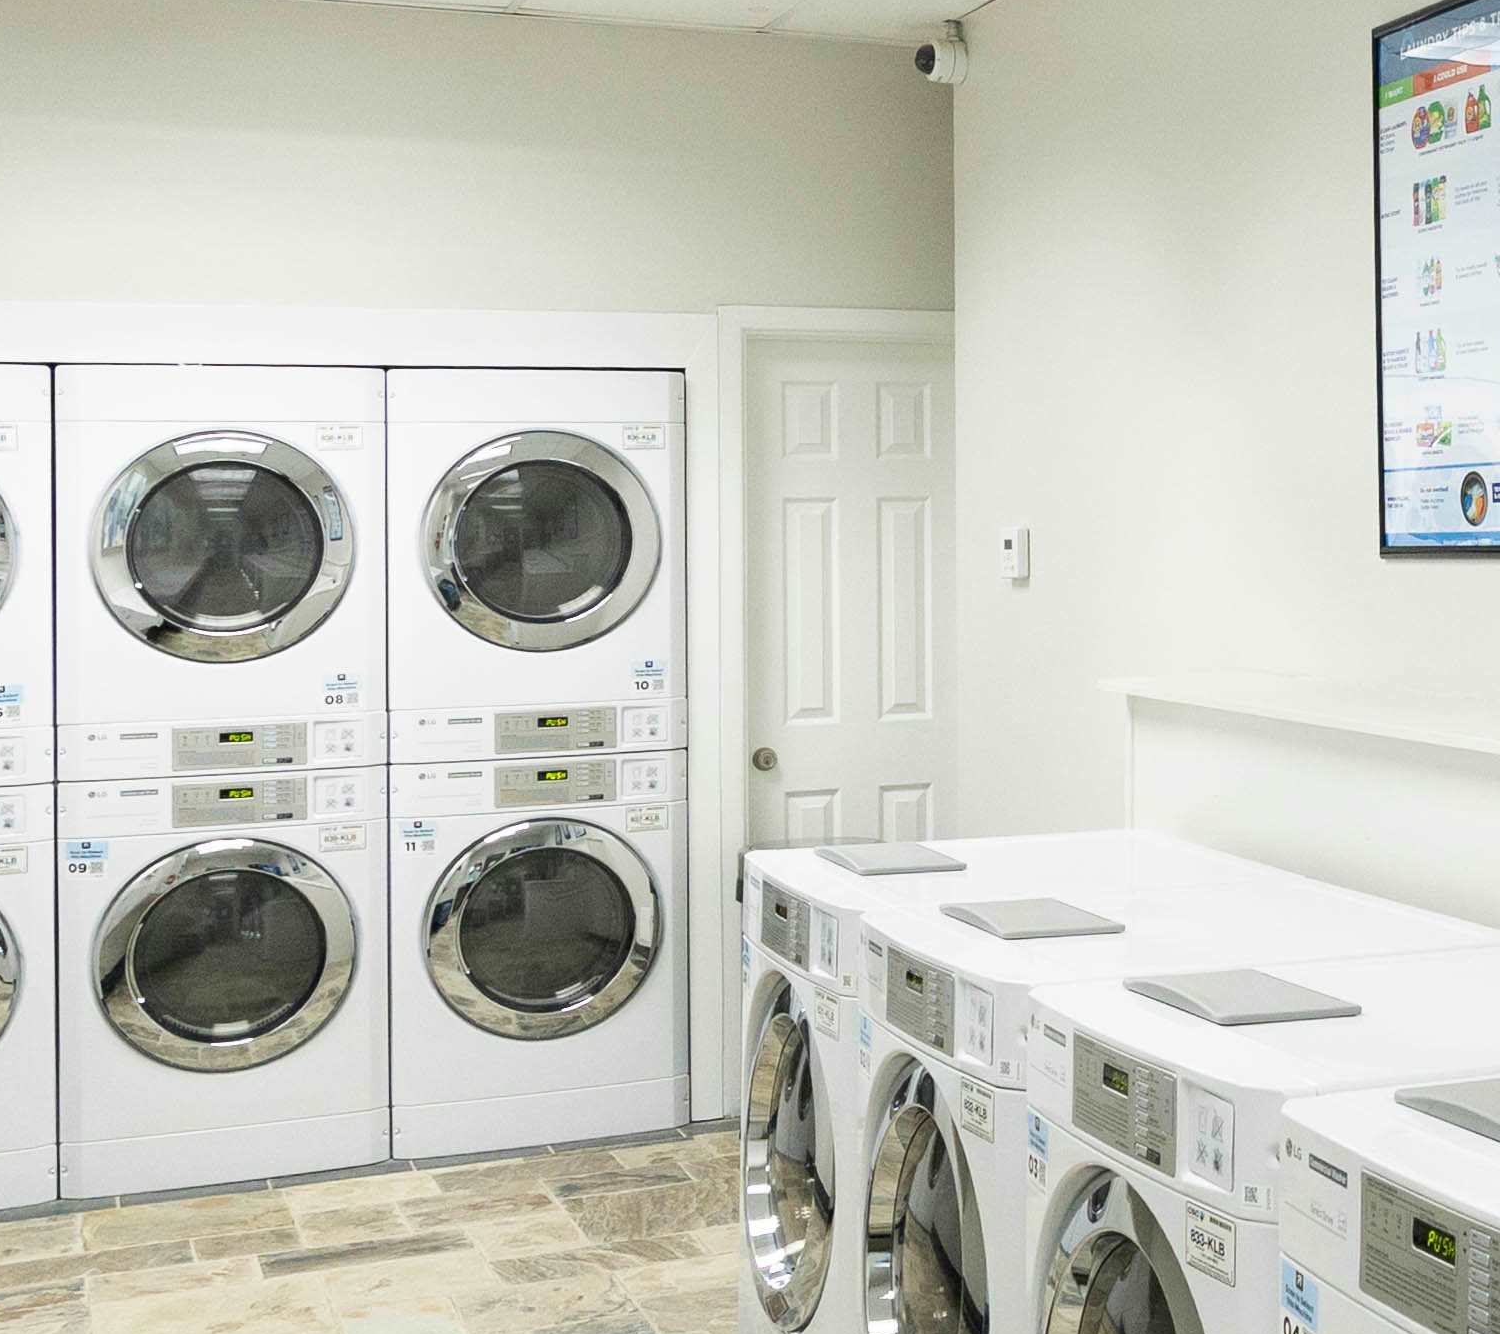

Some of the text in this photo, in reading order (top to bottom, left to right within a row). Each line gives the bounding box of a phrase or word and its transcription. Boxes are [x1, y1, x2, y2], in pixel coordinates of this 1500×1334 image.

[635, 680, 649, 691] 10
[325, 695, 343, 705] 08
[405, 842, 416, 852] 11
[69, 863, 87, 873] 09
[1029, 1155, 1038, 1178] 03
[1427, 1228, 1455, 1260] PUSH
